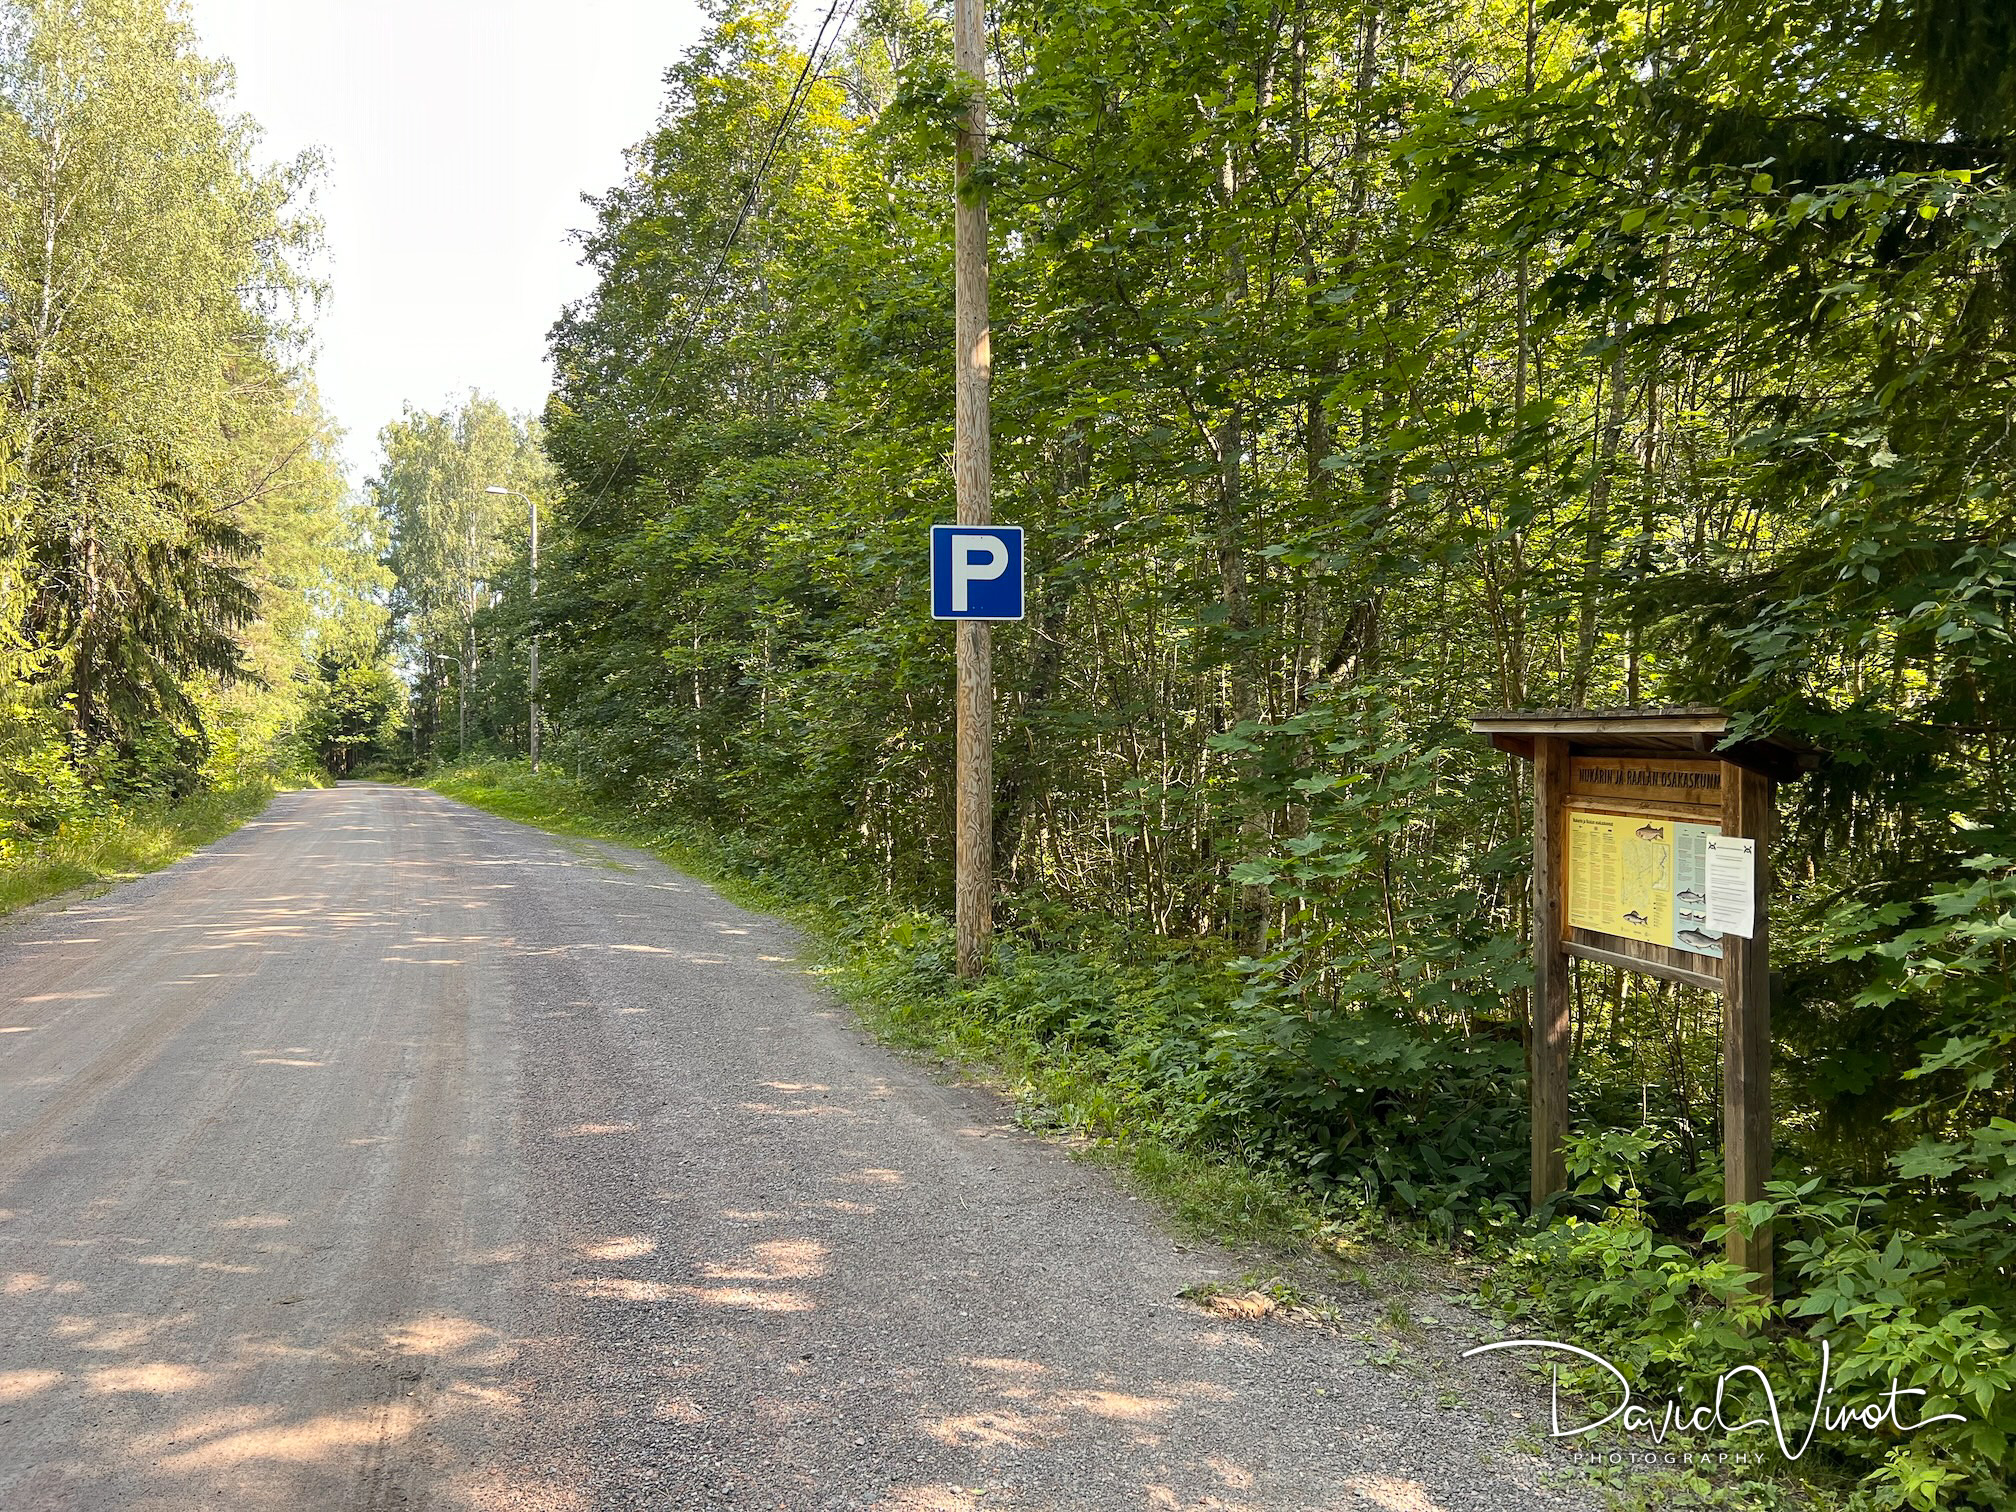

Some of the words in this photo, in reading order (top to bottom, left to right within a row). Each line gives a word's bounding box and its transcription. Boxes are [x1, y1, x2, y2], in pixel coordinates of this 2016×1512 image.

[952, 535, 1009, 611] P
[1615, 769, 1624, 785] JA
[1661, 771, 1722, 789] OSAKASKUNN
